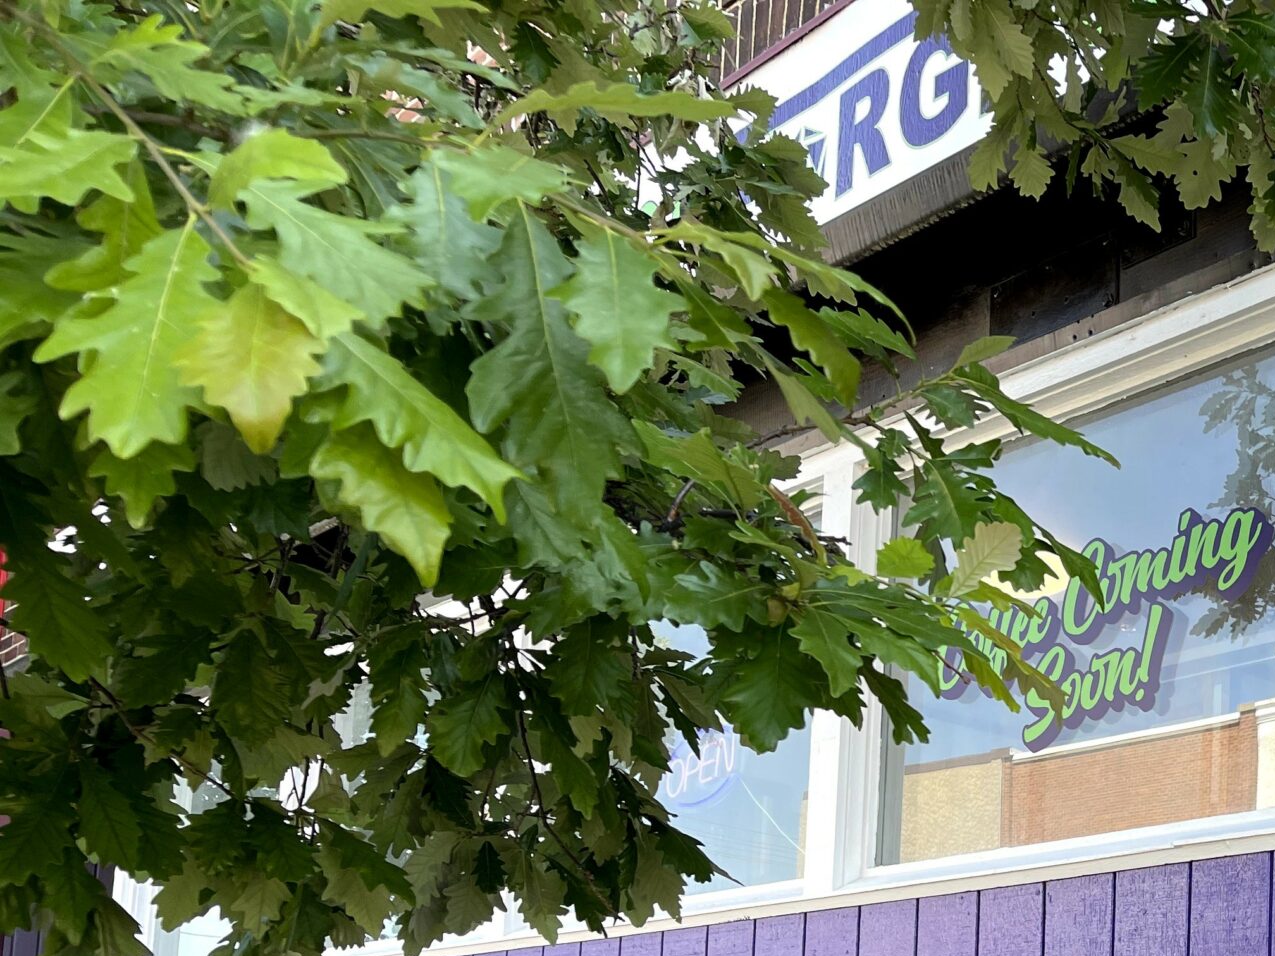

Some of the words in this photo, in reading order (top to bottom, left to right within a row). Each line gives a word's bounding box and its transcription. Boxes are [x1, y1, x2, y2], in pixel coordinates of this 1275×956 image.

[1062, 505, 1264, 637] Coming
[1022, 603, 1164, 743] Soon!
[664, 736, 736, 799] OPEN
